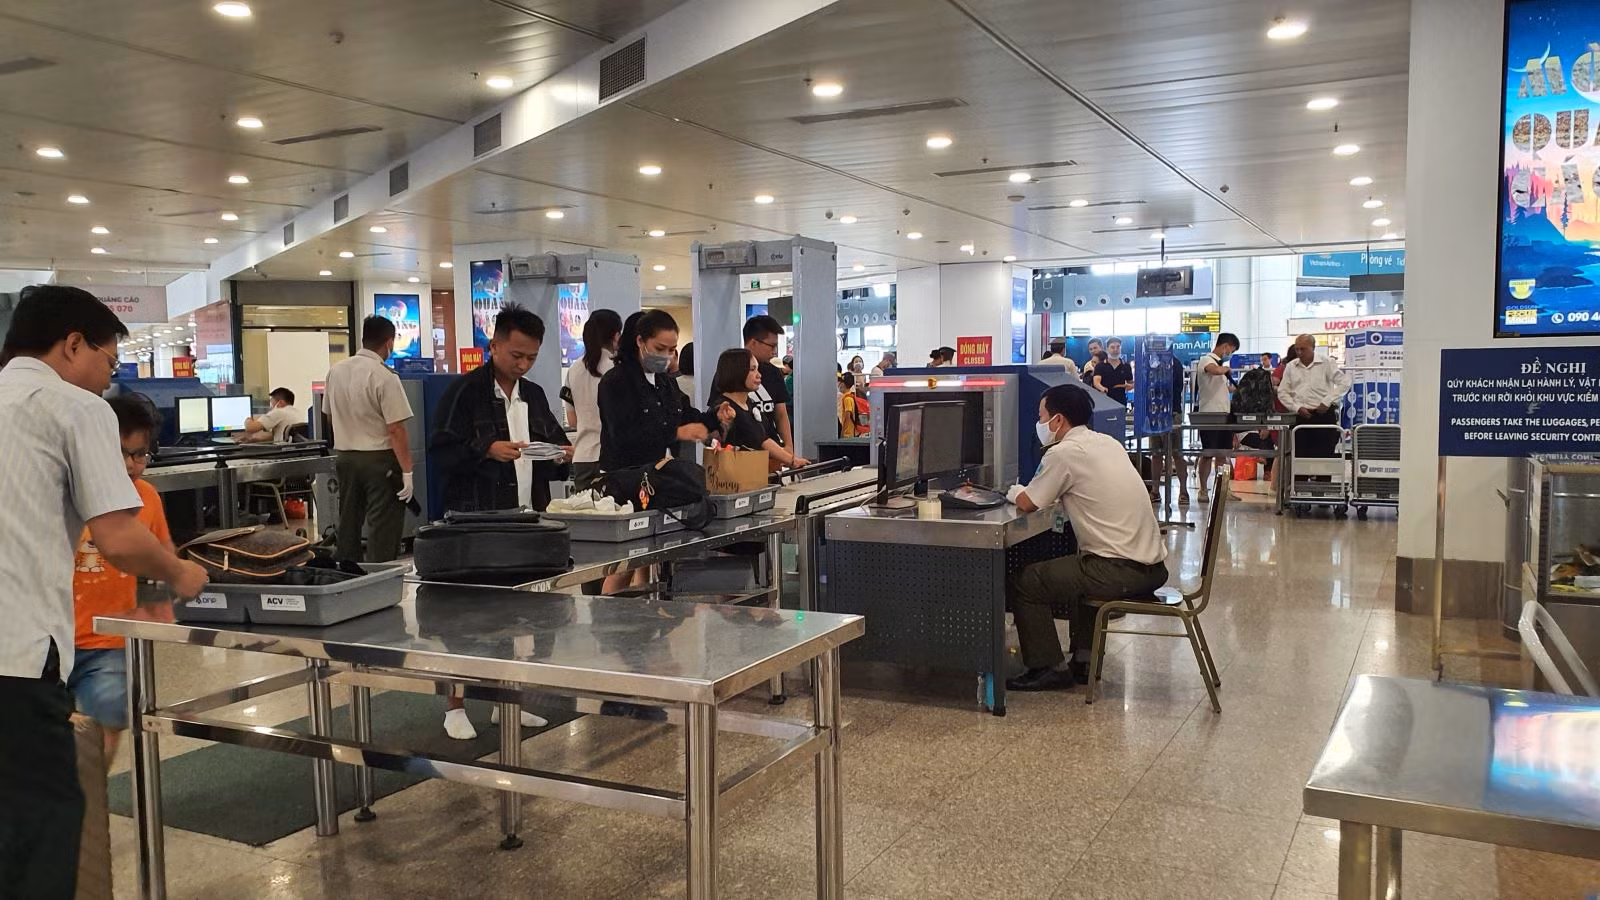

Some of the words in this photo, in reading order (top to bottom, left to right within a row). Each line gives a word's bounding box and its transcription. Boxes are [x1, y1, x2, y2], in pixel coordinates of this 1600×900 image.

[1567, 312, 1589, 322] 090
[1324, 321, 1356, 330] LUCKY
[1358, 320, 1379, 329] GIFT
[976, 341, 989, 354] MÁY
[1521, 356, 1541, 374] ĐỀ
[1546, 362, 1586, 375] NGHỊ
[1466, 378, 1494, 388] KHÁCH
[1496, 378, 1520, 389] NHẬN
[1522, 379, 1535, 389] LẠI
[1537, 377, 1561, 387] HÀNH
[1579, 377, 1596, 389] VẬT
[1452, 391, 1480, 402] TRƯỚC
[1482, 394, 1496, 402] KHI
[1498, 391, 1512, 402] RỜI
[1514, 390, 1535, 402] KHỎI
[1537, 393, 1555, 402] KHU
[1557, 393, 1575, 404] VỰC
[1577, 389, 1599, 402] KIỂM
[1451, 418, 1500, 426] PASSENGERS
[1503, 418, 1523, 426] TAKE
[1525, 418, 1540, 426] THE
[1542, 418, 1589, 428] LUGGAGES,
[1464, 432, 1493, 440] BEFORE
[1495, 432, 1529, 440] LEAVING
[1530, 433, 1569, 441] SECURITY
[267, 597, 283, 605] ACV
